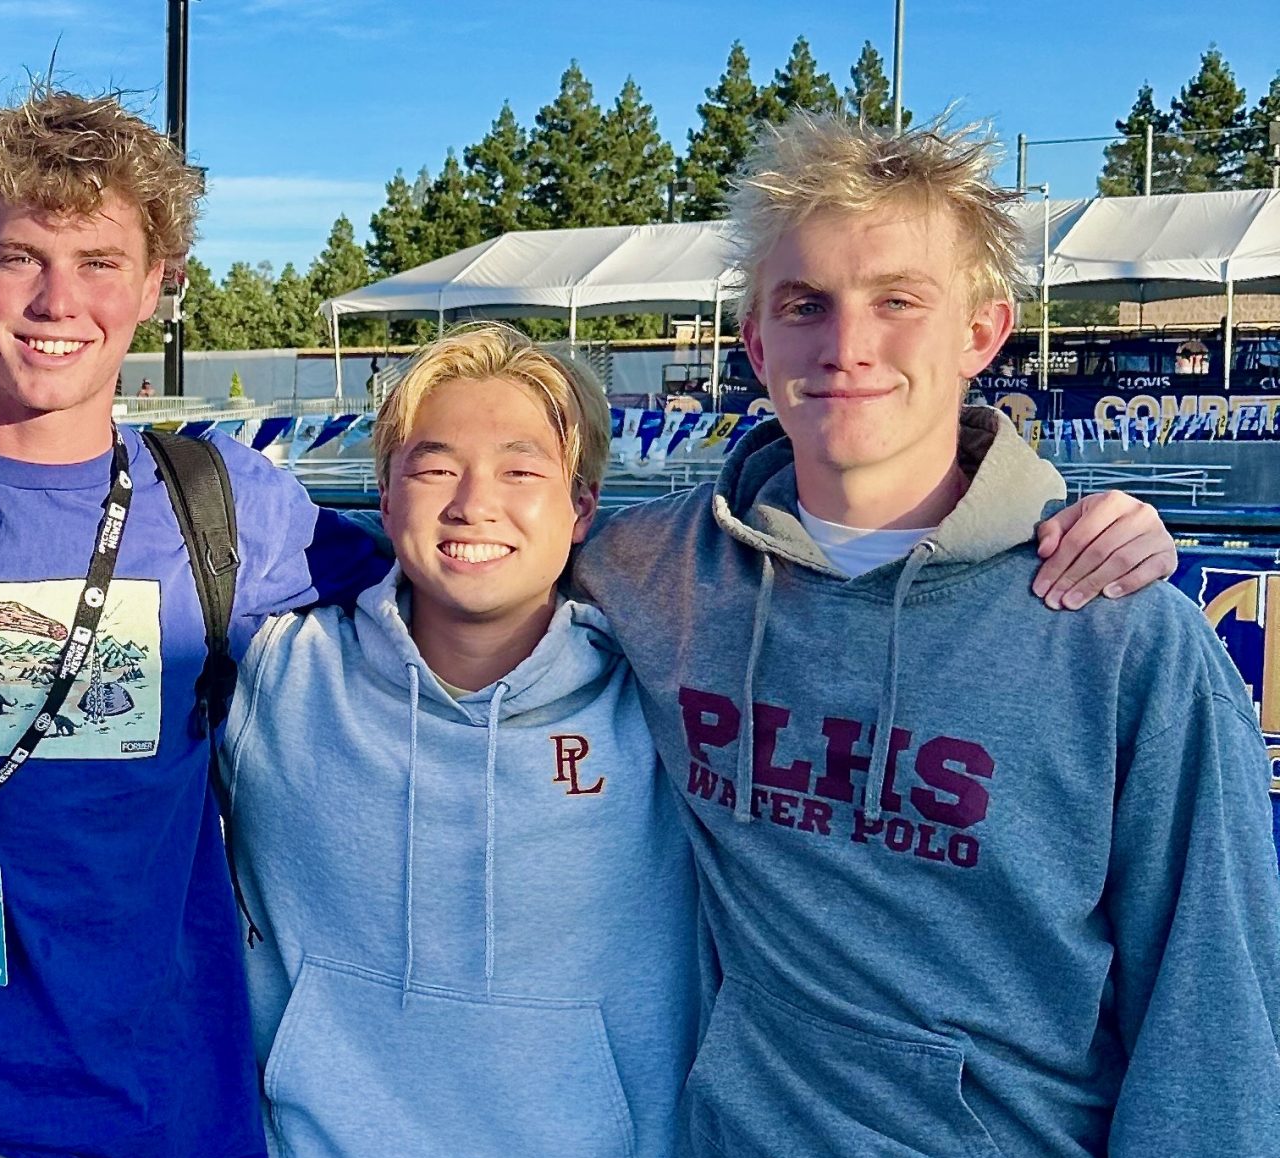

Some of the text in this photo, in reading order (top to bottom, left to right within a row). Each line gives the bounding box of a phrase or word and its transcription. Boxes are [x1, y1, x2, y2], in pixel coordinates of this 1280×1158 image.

[69, 644, 86, 675] NEWS
[679, 686, 995, 829] PLHS
[851, 809, 980, 869] POLO
